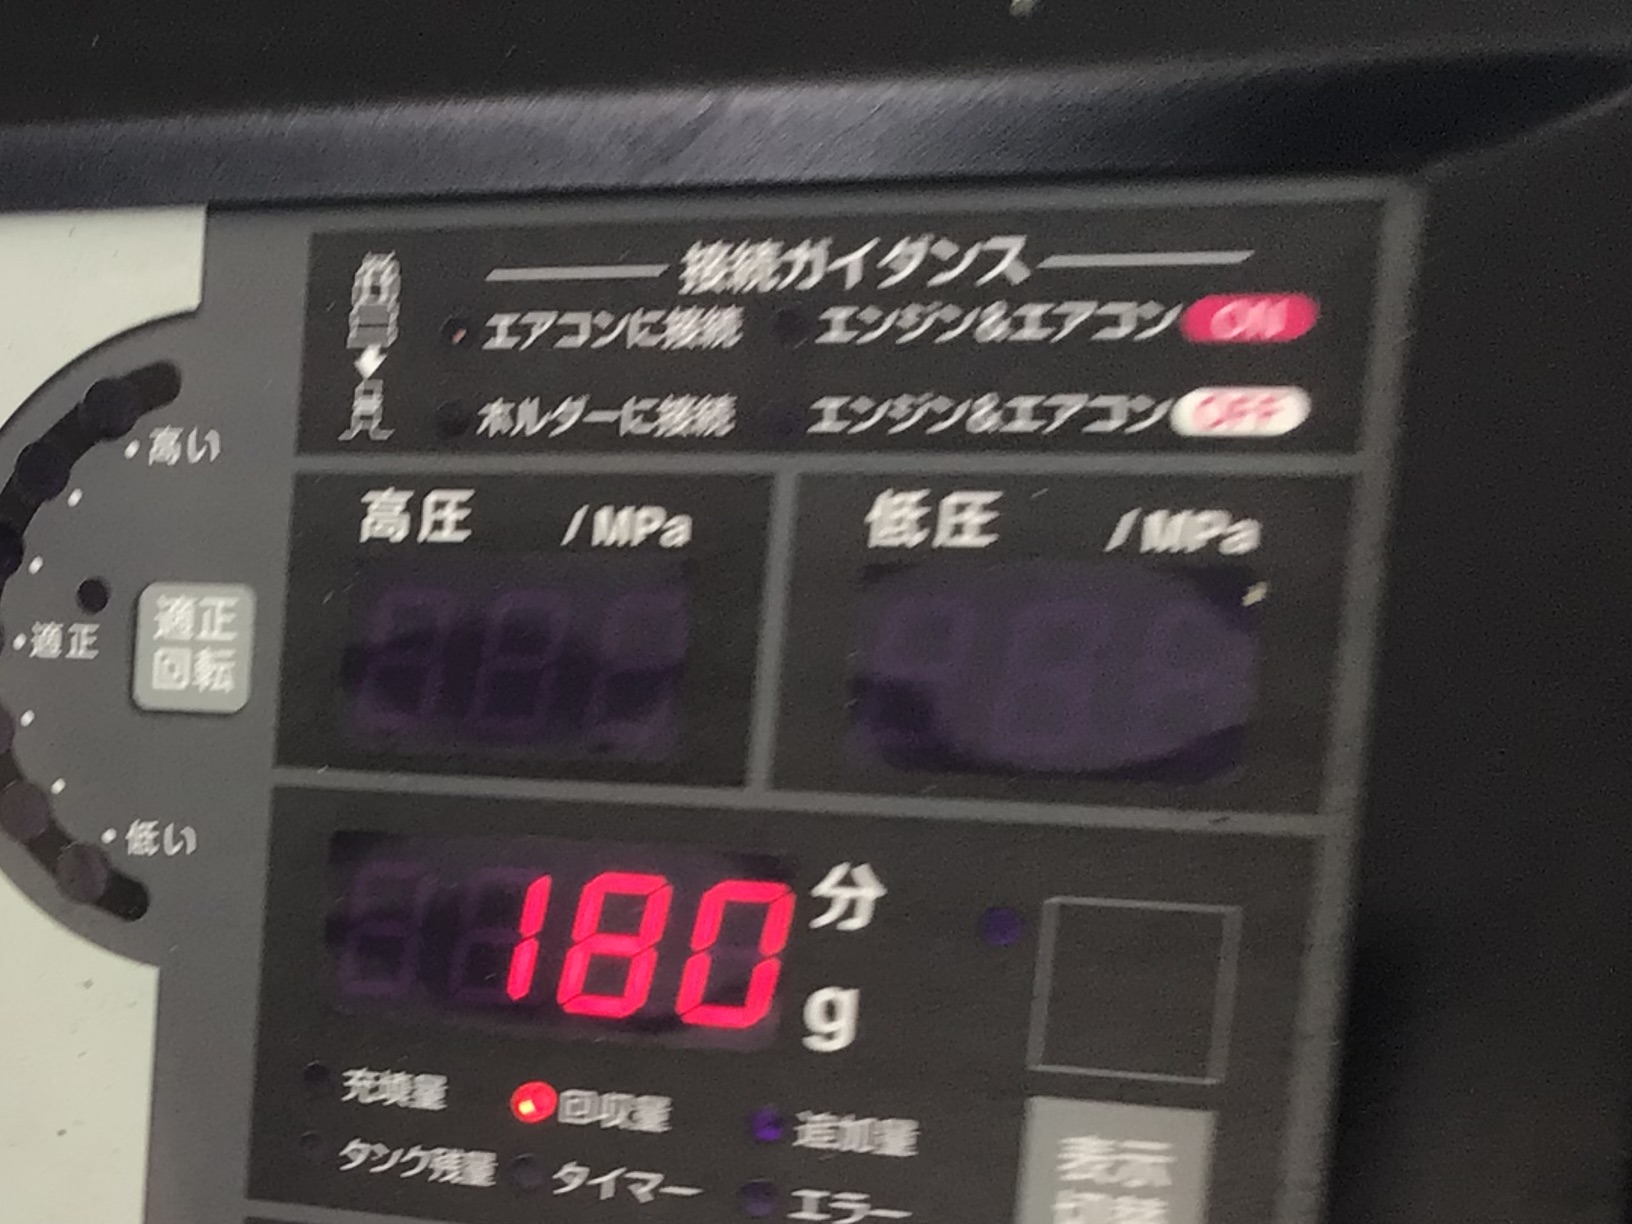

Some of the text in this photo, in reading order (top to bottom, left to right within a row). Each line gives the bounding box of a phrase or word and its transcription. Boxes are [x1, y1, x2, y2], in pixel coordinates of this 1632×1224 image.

[481, 304, 745, 350] エアコンに接続
[148, 425, 221, 465] 高い
[359, 486, 475, 545] 高圧
[561, 504, 693, 548] /MPa
[29, 621, 100, 660] 適正
[153, 594, 239, 645] 適正
[152, 647, 236, 693] 回転
[125, 819, 198, 859] 低い
[809, 861, 887, 932] 分
[505, 872, 796, 1029] 180
[802, 984, 861, 1050] g
[342, 1065, 448, 1112] 充填量
[558, 1087, 672, 1133] 回収量
[793, 1110, 920, 1156] 追加量
[552, 1159, 703, 1203] タイマー
[1056, 1134, 1175, 1189] 表示
